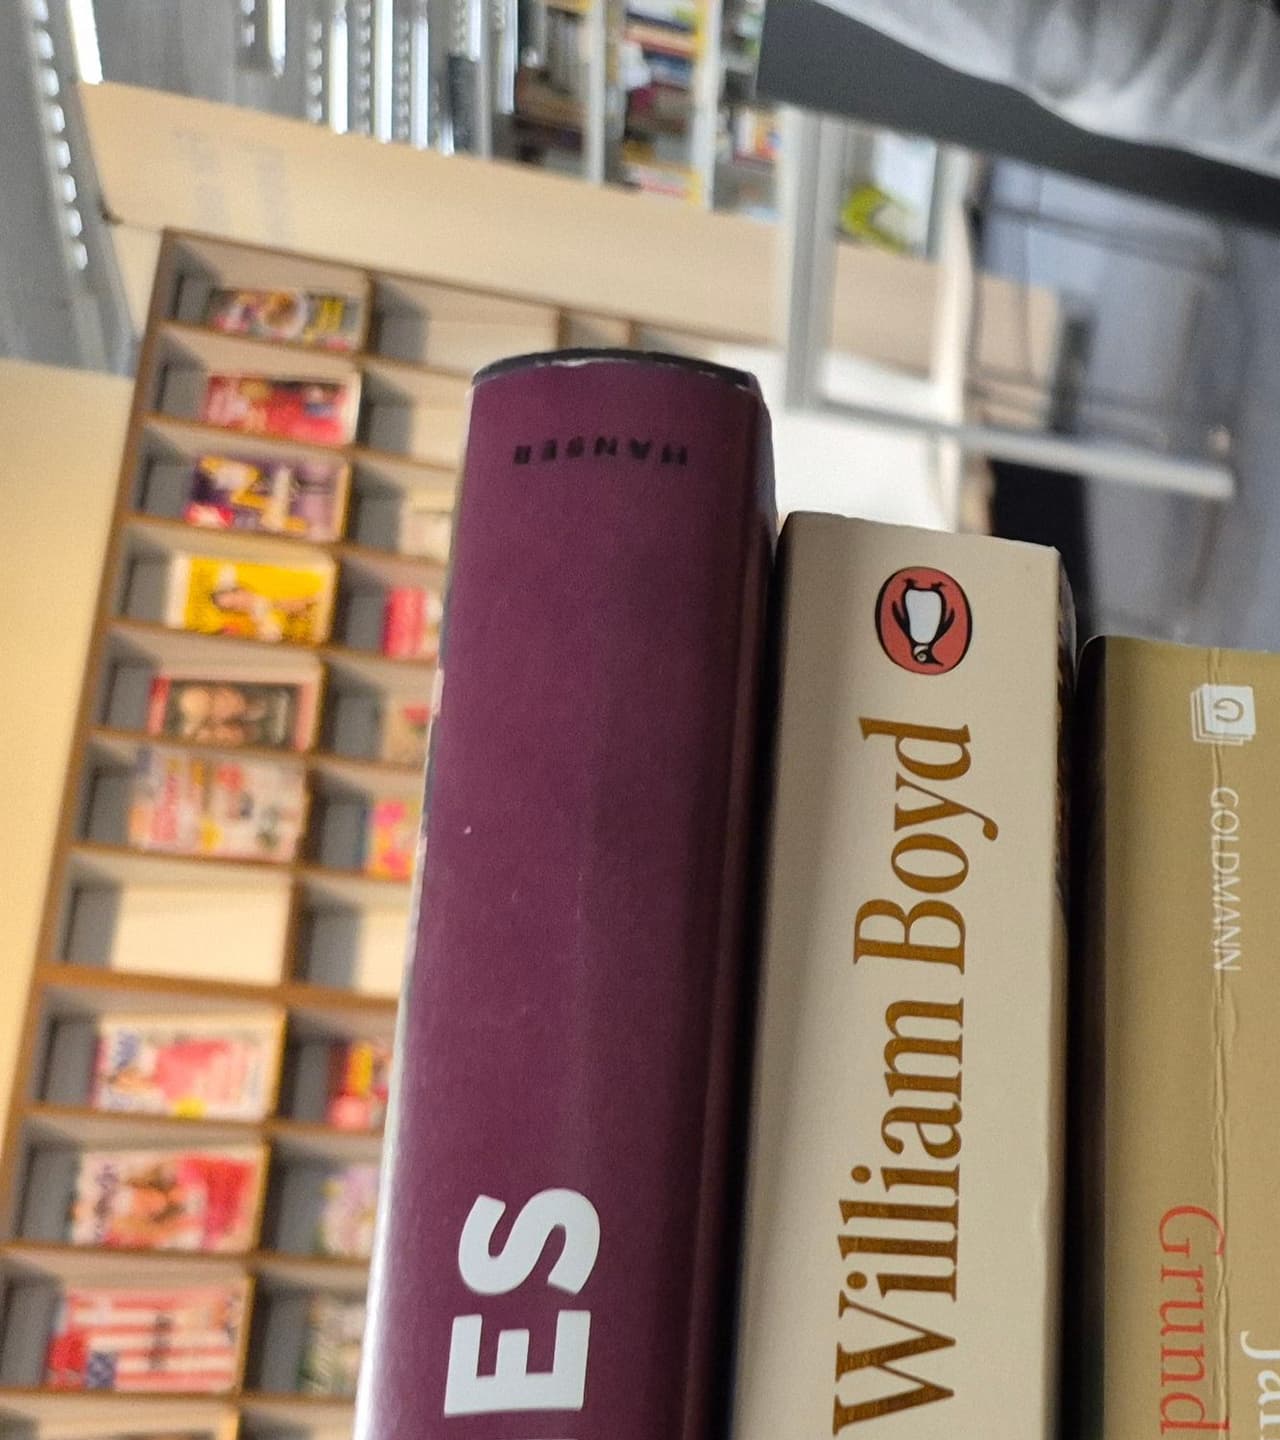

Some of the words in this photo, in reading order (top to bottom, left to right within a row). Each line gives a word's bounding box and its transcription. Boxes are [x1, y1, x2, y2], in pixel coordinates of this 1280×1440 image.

[852, 716, 998, 975] Boyd
[1211, 786, 1242, 972] GOLDMANN
[832, 997, 967, 1437] William
[1157, 1204, 1231, 1436] Grund
